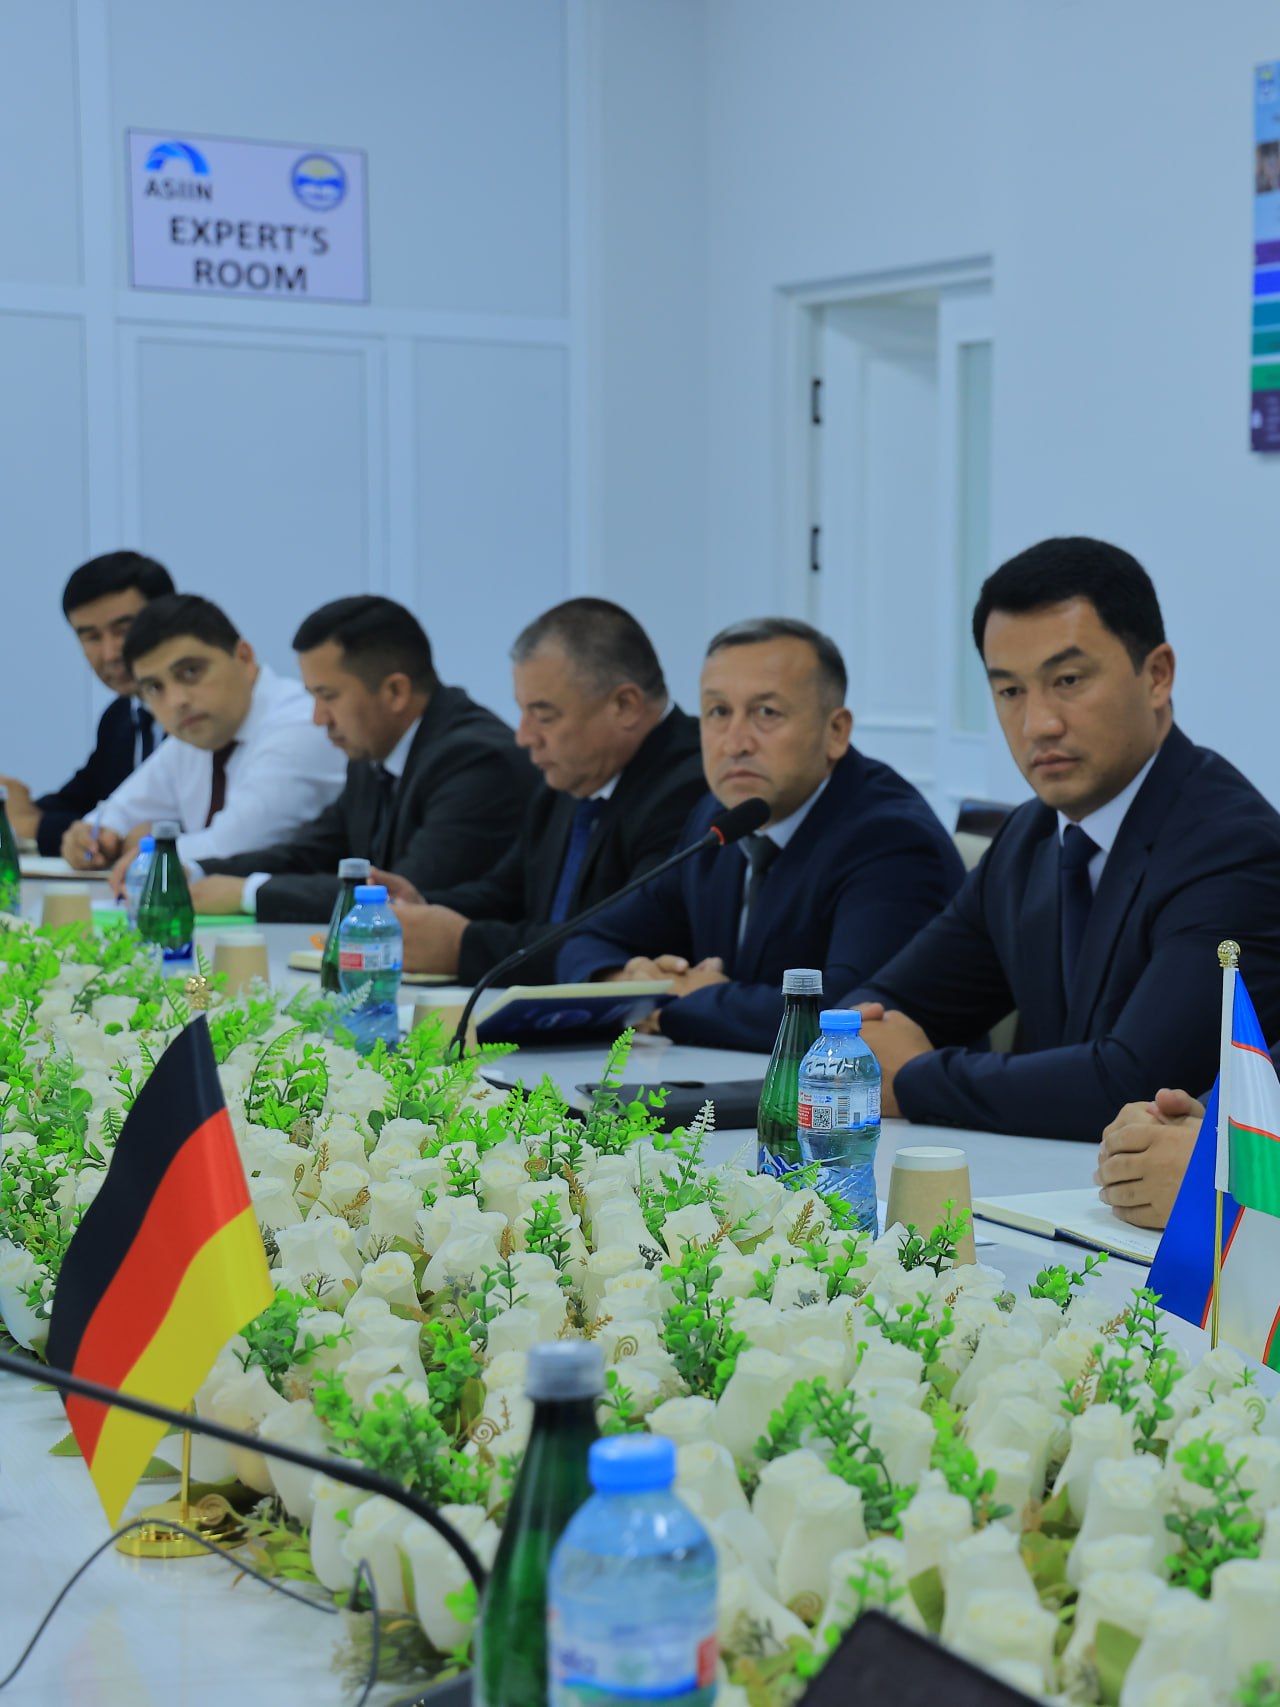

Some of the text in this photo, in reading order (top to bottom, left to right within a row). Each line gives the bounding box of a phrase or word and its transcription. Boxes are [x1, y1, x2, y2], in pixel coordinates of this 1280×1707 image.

[145, 178, 212, 201] ASIIN
[170, 215, 329, 255] EXPERT'S
[194, 258, 308, 291] ROOM
